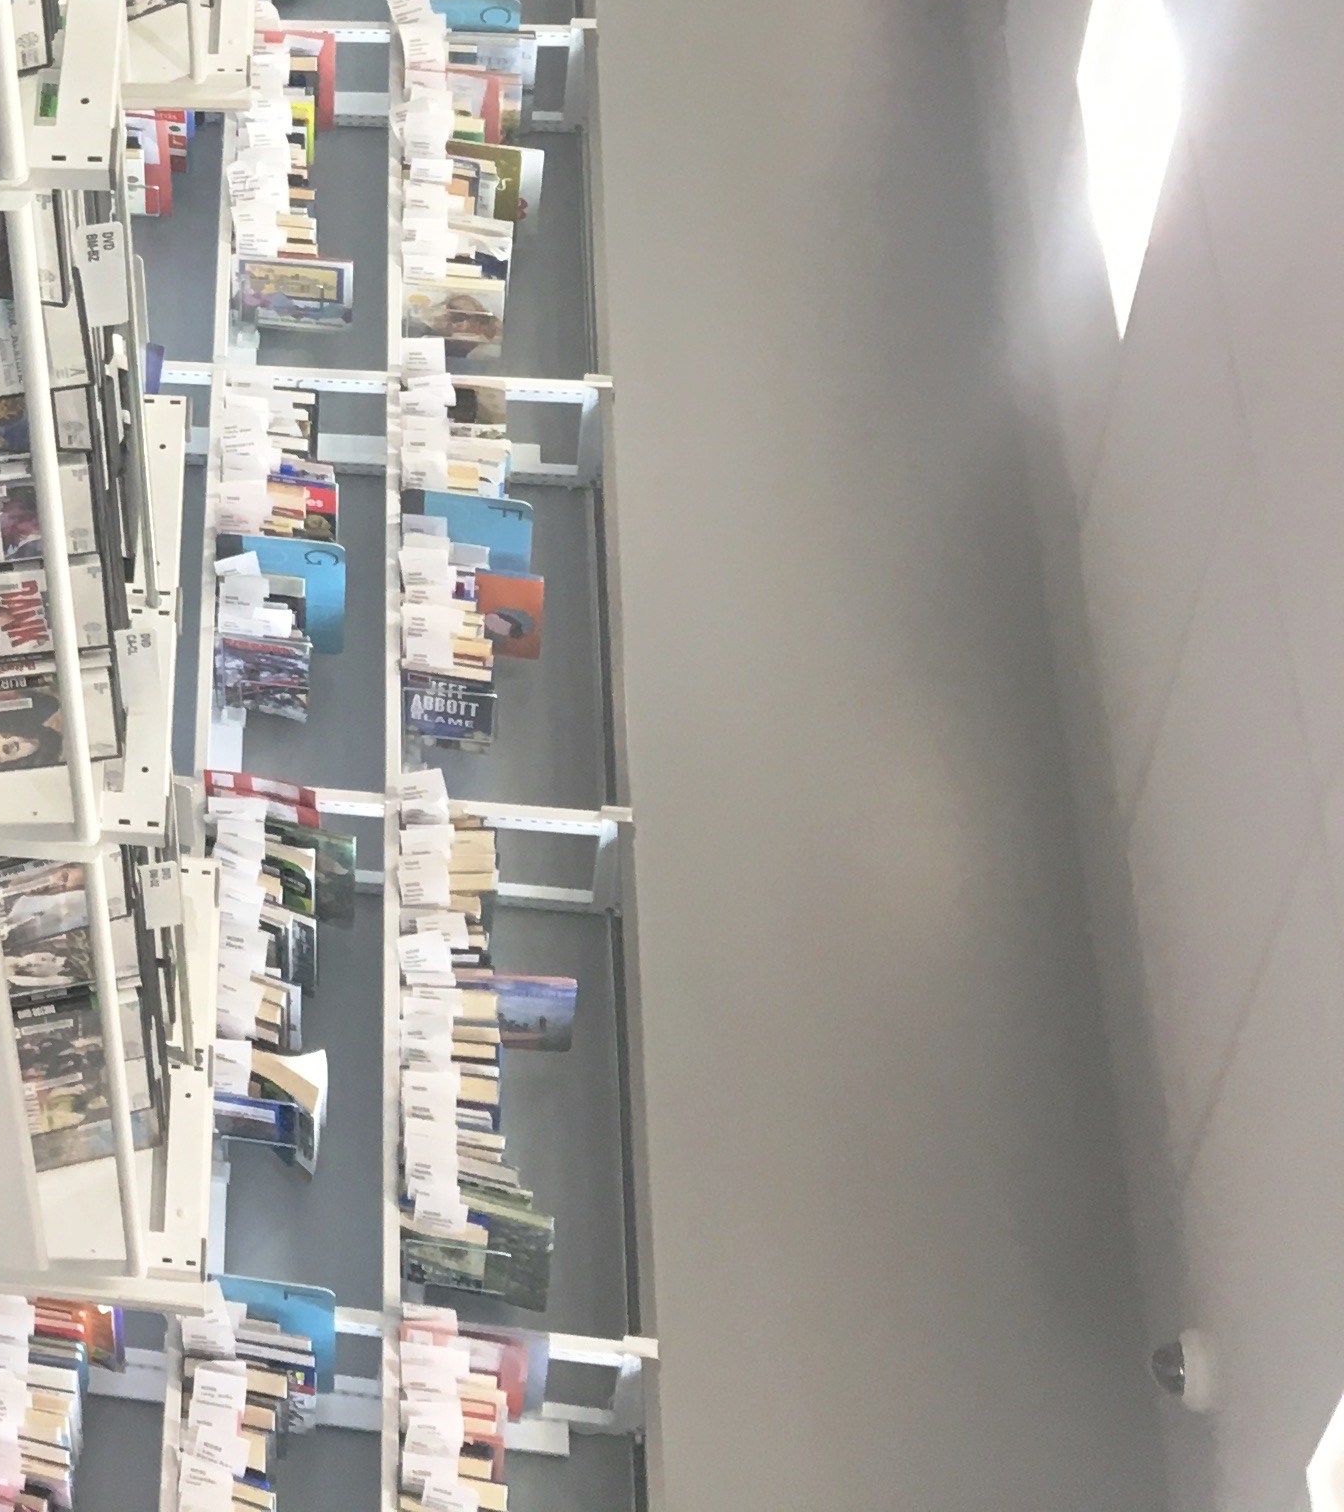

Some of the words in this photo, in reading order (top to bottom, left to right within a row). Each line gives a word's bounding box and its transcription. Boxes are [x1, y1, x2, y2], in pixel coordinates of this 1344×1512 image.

[478, 5, 512, 24] C
[102, 231, 115, 251] DVD
[303, 549, 339, 567] G
[425, 680, 467, 699] JEFF
[411, 693, 480, 718] ABBOTT
